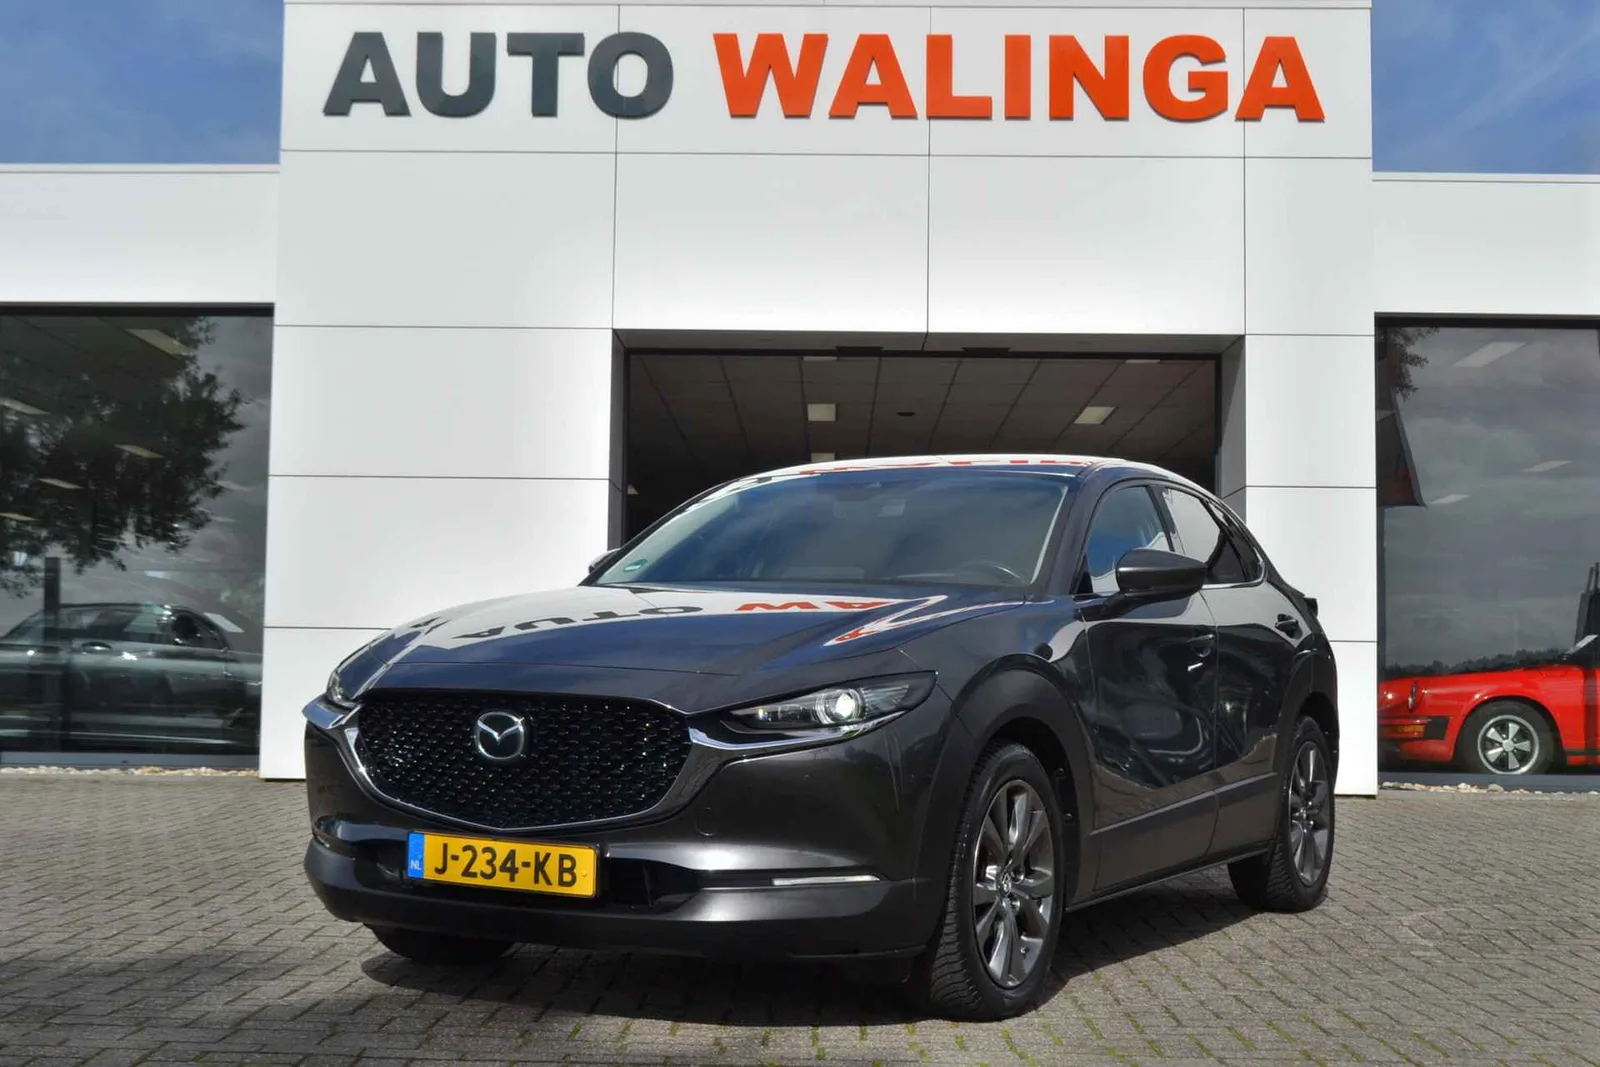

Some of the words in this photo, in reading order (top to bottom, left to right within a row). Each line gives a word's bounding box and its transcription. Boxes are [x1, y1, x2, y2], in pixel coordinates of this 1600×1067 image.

[323, 32, 674, 119] AUTO
[714, 33, 1325, 122] WALINGA
[410, 859, 422, 871] NL
[434, 842, 577, 888] J-234-KB
